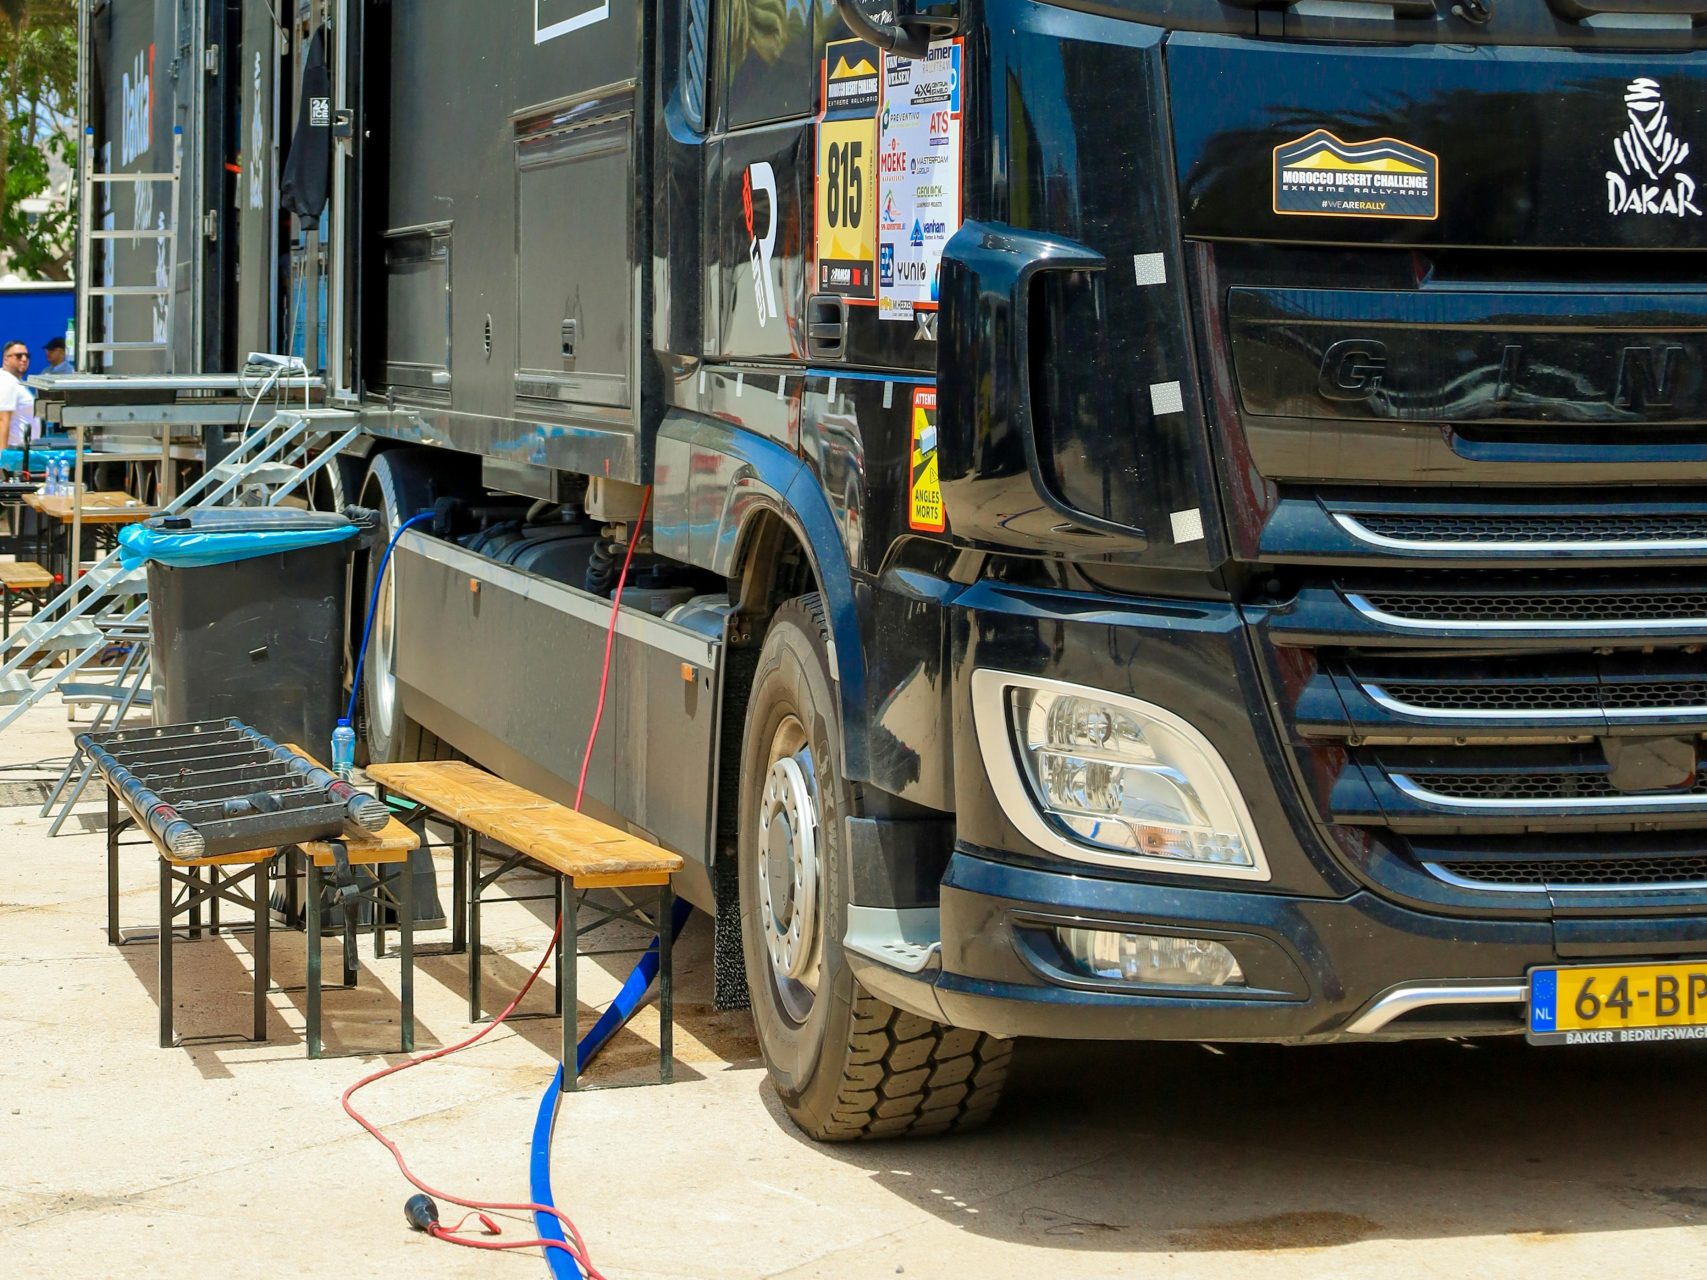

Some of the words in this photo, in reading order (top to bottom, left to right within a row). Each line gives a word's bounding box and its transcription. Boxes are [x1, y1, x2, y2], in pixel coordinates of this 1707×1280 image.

[921, 46, 952, 62] amer
[312, 109, 329, 118] ICE
[929, 110, 949, 134] ATS
[880, 151, 907, 173] MOEKE
[827, 141, 863, 229] 815
[1282, 170, 1334, 185] MOROCCO
[1335, 172, 1372, 187] DESERT
[1373, 174, 1429, 189] CHALLENGE
[1282, 185, 1345, 193] EXTREME
[1353, 187, 1429, 196] RALLY-RAID
[1605, 170, 1703, 218] DAKAR
[1321, 200, 1386, 210] #WEARERALLY
[914, 489, 940, 504] ANGLES
[915, 505, 939, 520] MORTS
[1574, 972, 1707, 1021] 64-BP
[1535, 1007, 1553, 1020] NL
[1565, 1030, 1614, 1045] BAKKER
[1620, 1026, 1707, 1043] BEDRIJFSWAG
